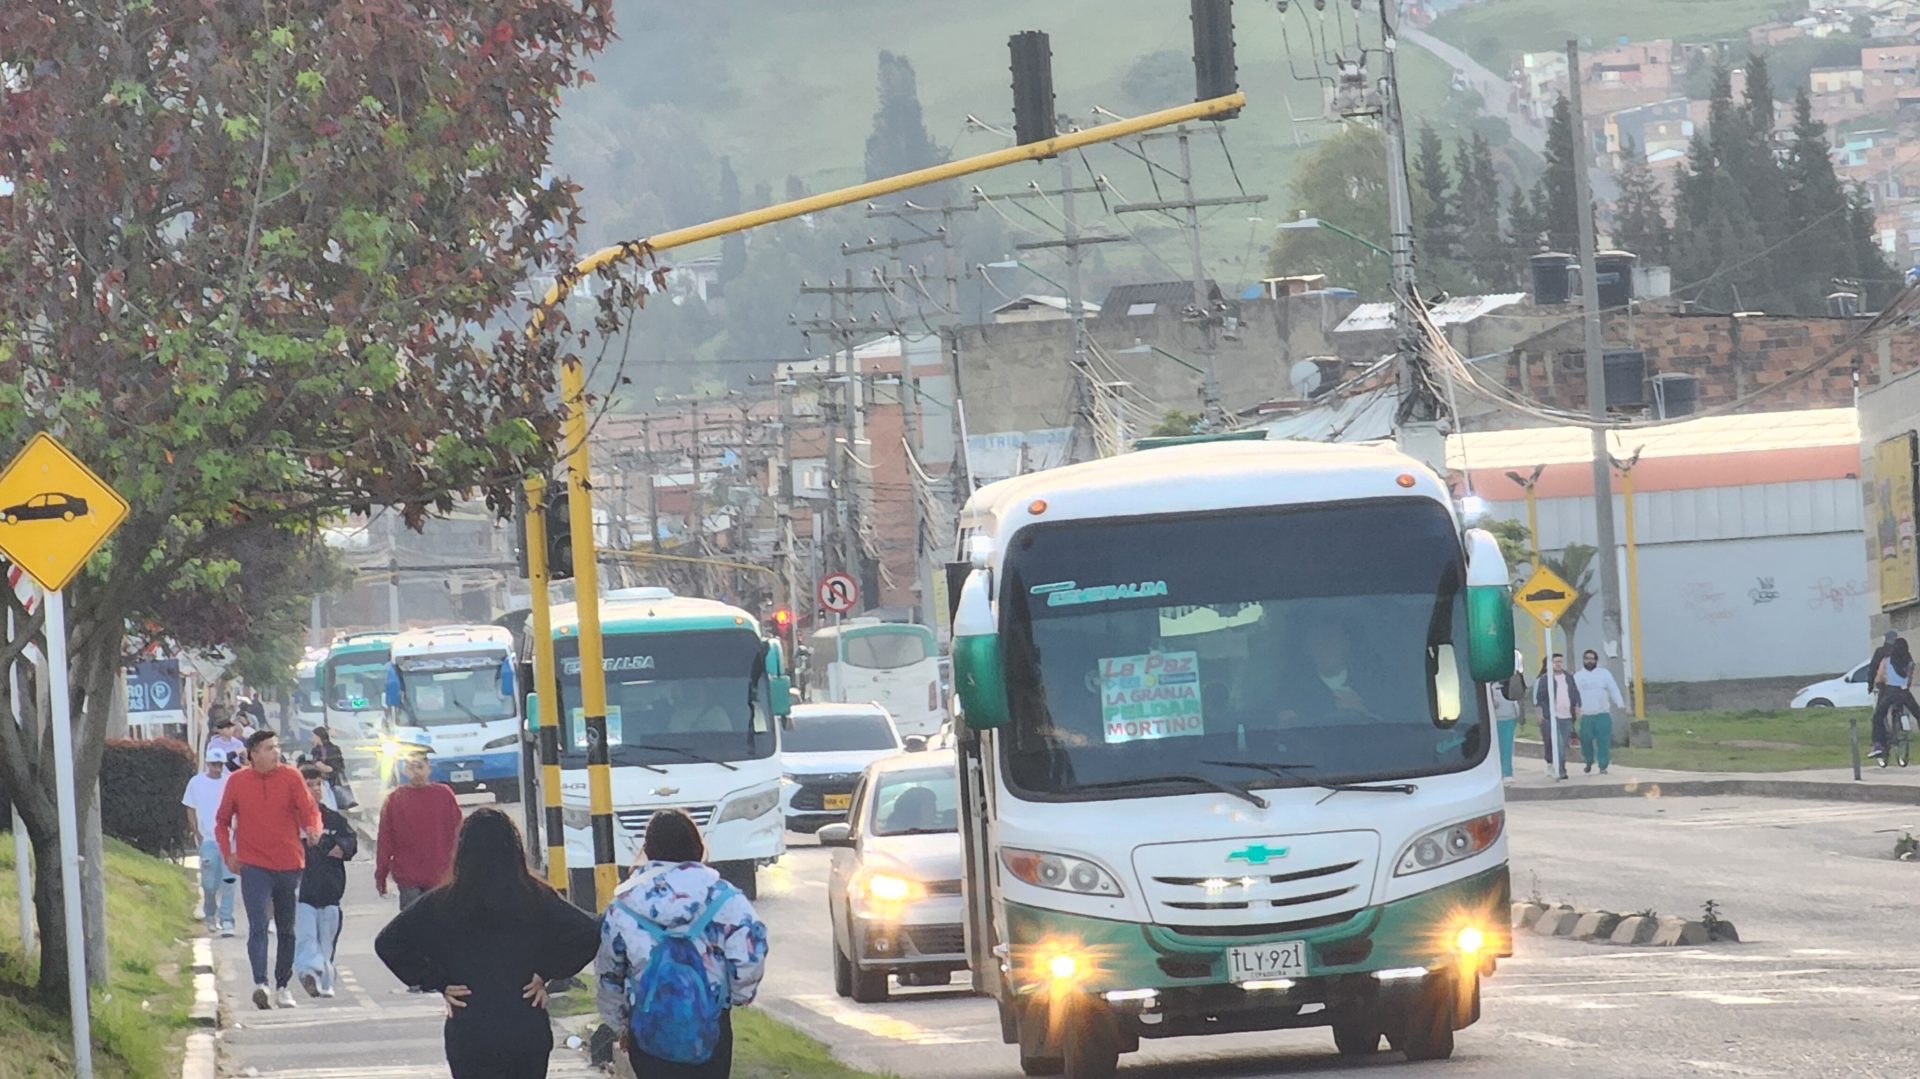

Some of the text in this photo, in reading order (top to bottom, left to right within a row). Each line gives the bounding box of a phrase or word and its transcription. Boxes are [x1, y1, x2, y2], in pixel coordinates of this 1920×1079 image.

[1144, 654, 1193, 674] Paz
[1106, 686, 1196, 705] LA GRANJA
[1107, 716, 1201, 736] MORTINO
